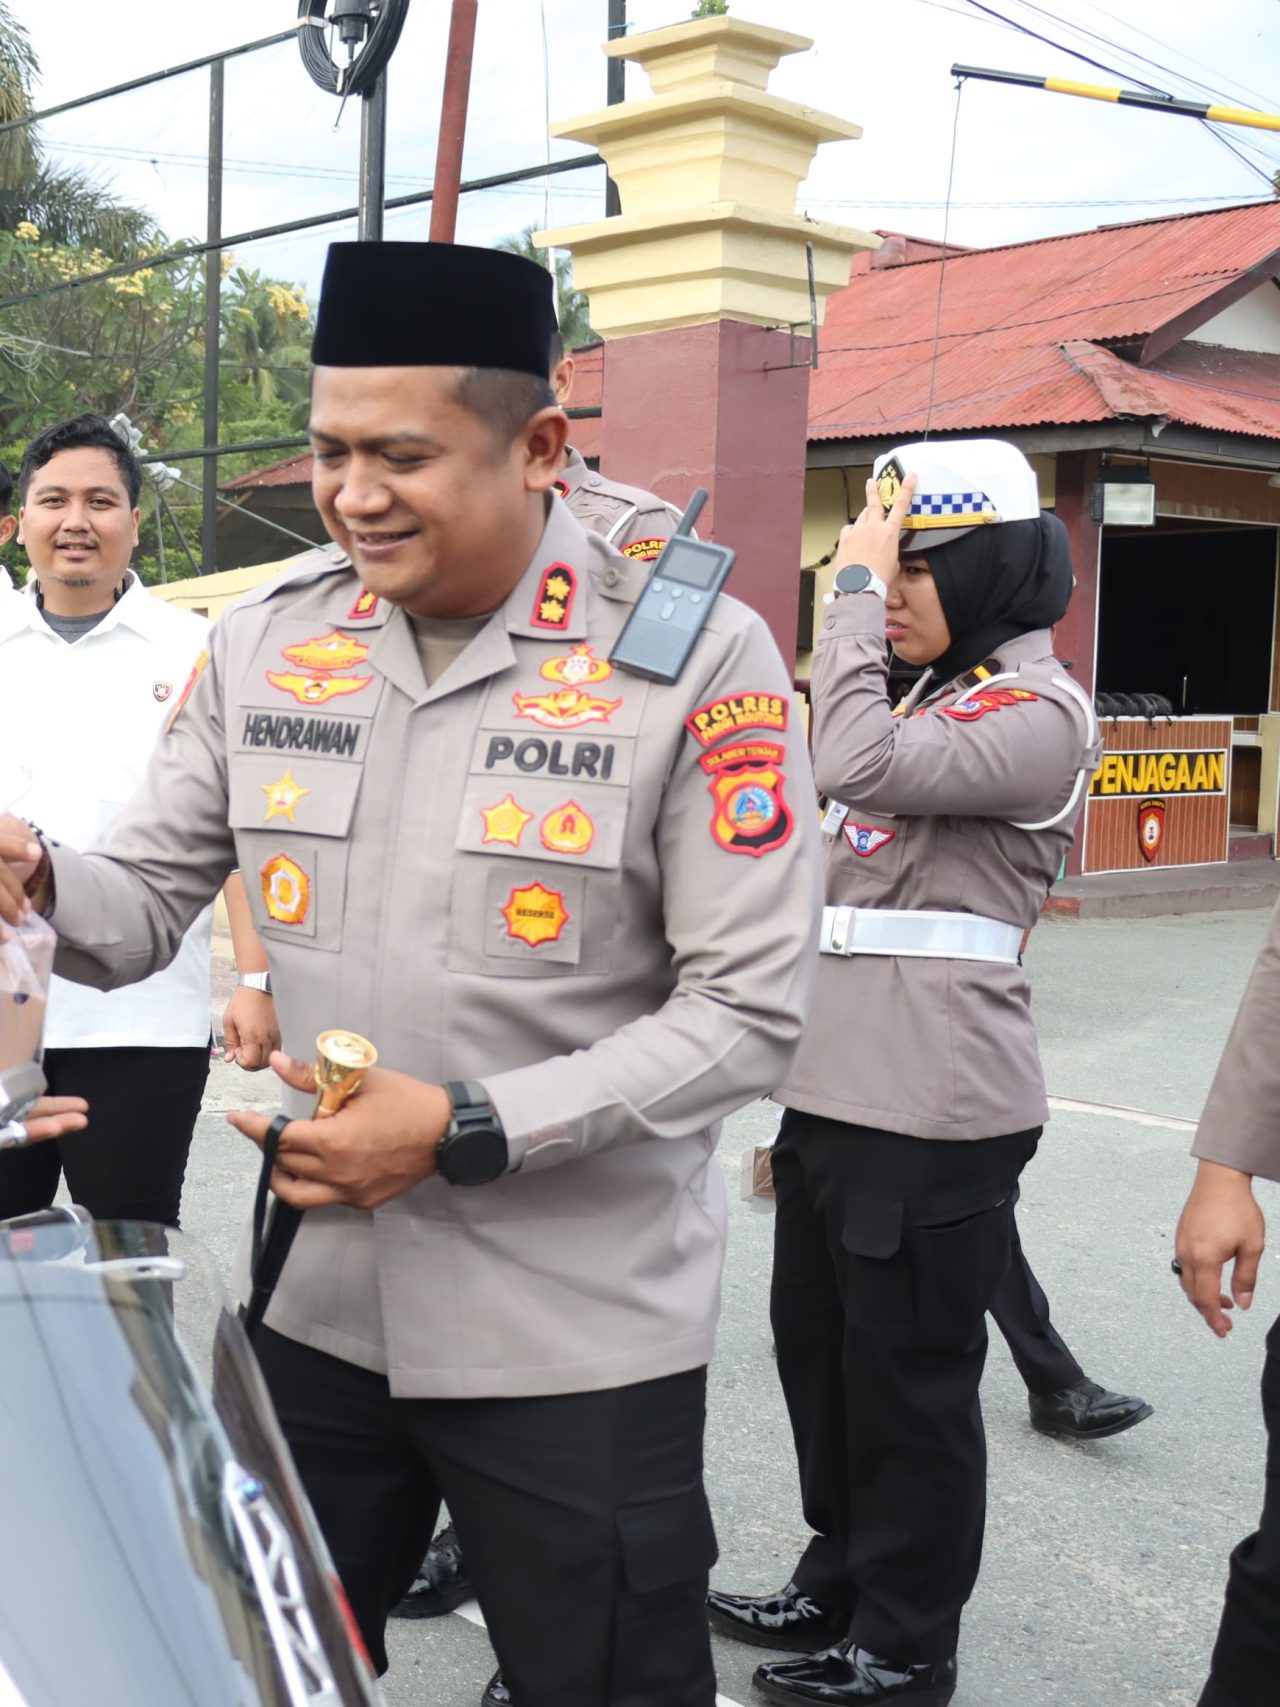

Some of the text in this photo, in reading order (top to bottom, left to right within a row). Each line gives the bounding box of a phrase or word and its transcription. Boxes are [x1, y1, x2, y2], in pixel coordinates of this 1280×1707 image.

[623, 541, 667, 558] POLRE
[694, 696, 783, 731] POLRES
[242, 713, 361, 758] HENDRAWAN
[485, 736, 615, 779] POLRI
[1088, 753, 1224, 795] PENJAGAAN
